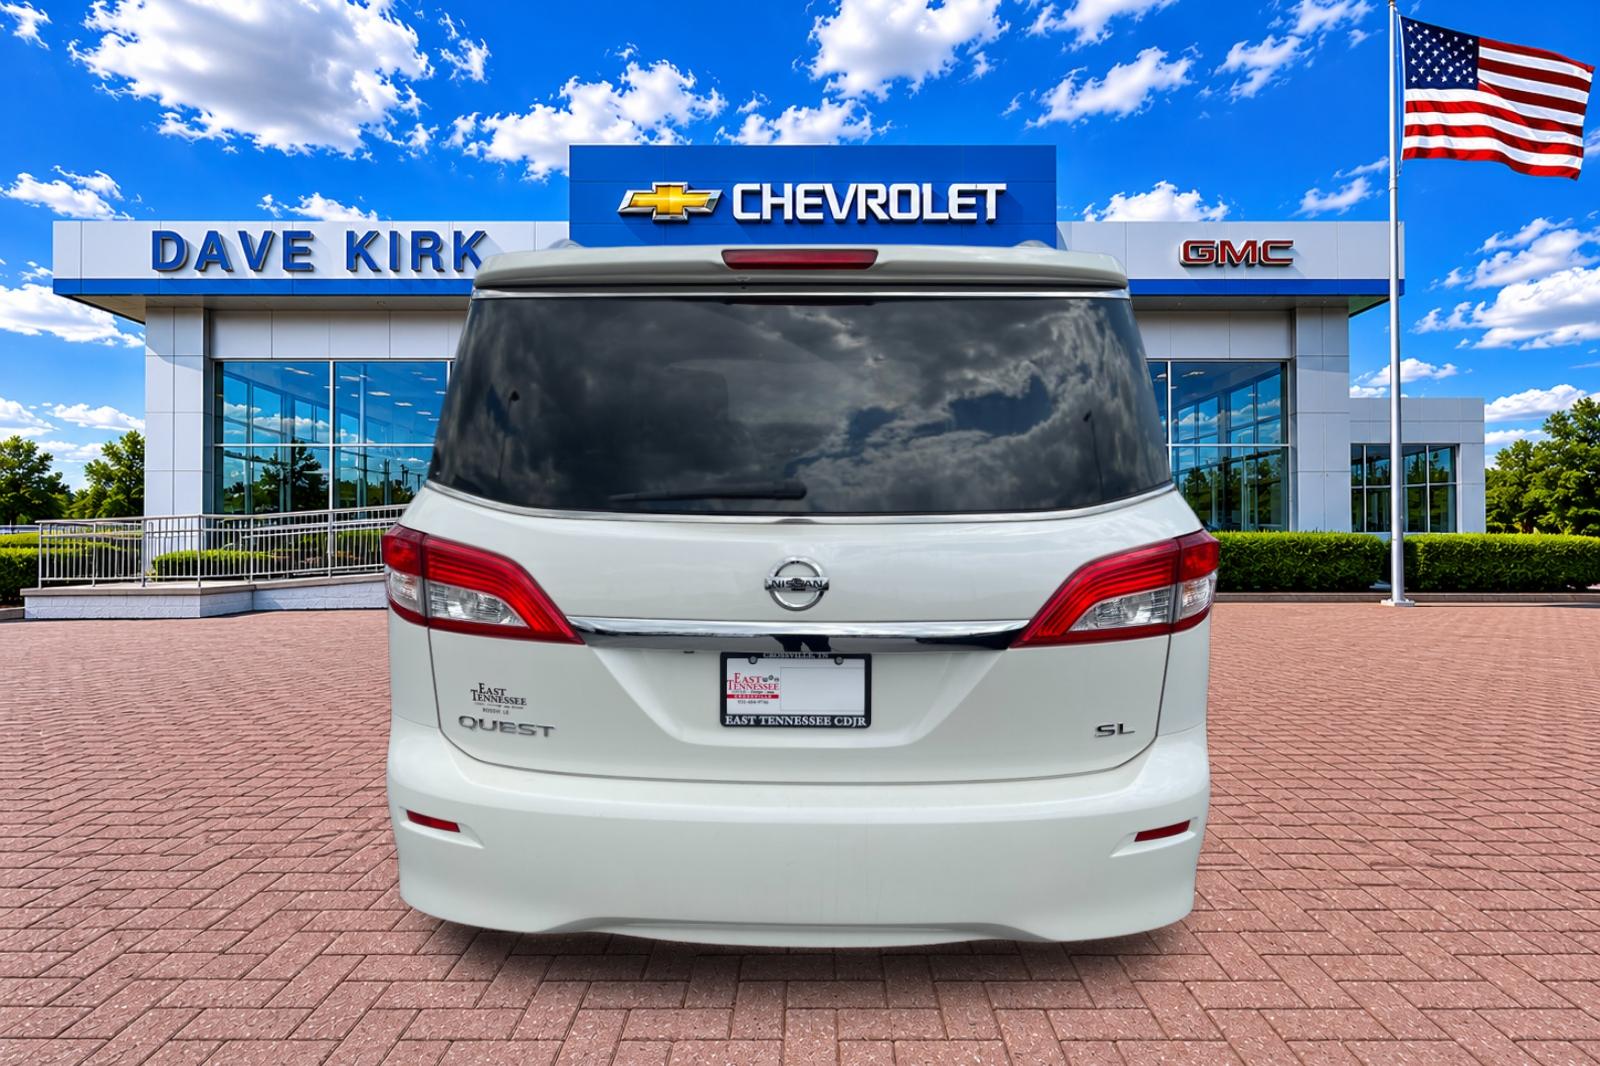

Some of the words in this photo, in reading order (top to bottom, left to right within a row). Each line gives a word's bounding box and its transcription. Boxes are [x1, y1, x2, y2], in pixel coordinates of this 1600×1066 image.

[733, 183, 1007, 221] CHEVROLET
[152, 230, 314, 272] DAVE
[346, 230, 486, 272] KIRK
[1180, 239, 1295, 267] GMC
[771, 580, 823, 589] NISSAN
[727, 679, 780, 691] TENNESSEE
[734, 672, 762, 684] EAST
[479, 682, 507, 697] EAST
[470, 689, 528, 706] TENNESSEE
[458, 715, 556, 738] QUEST
[725, 716, 756, 726] EAST
[759, 716, 832, 726] TENNESSEE
[834, 716, 867, 728] CDJR
[1094, 723, 1136, 738] SL
